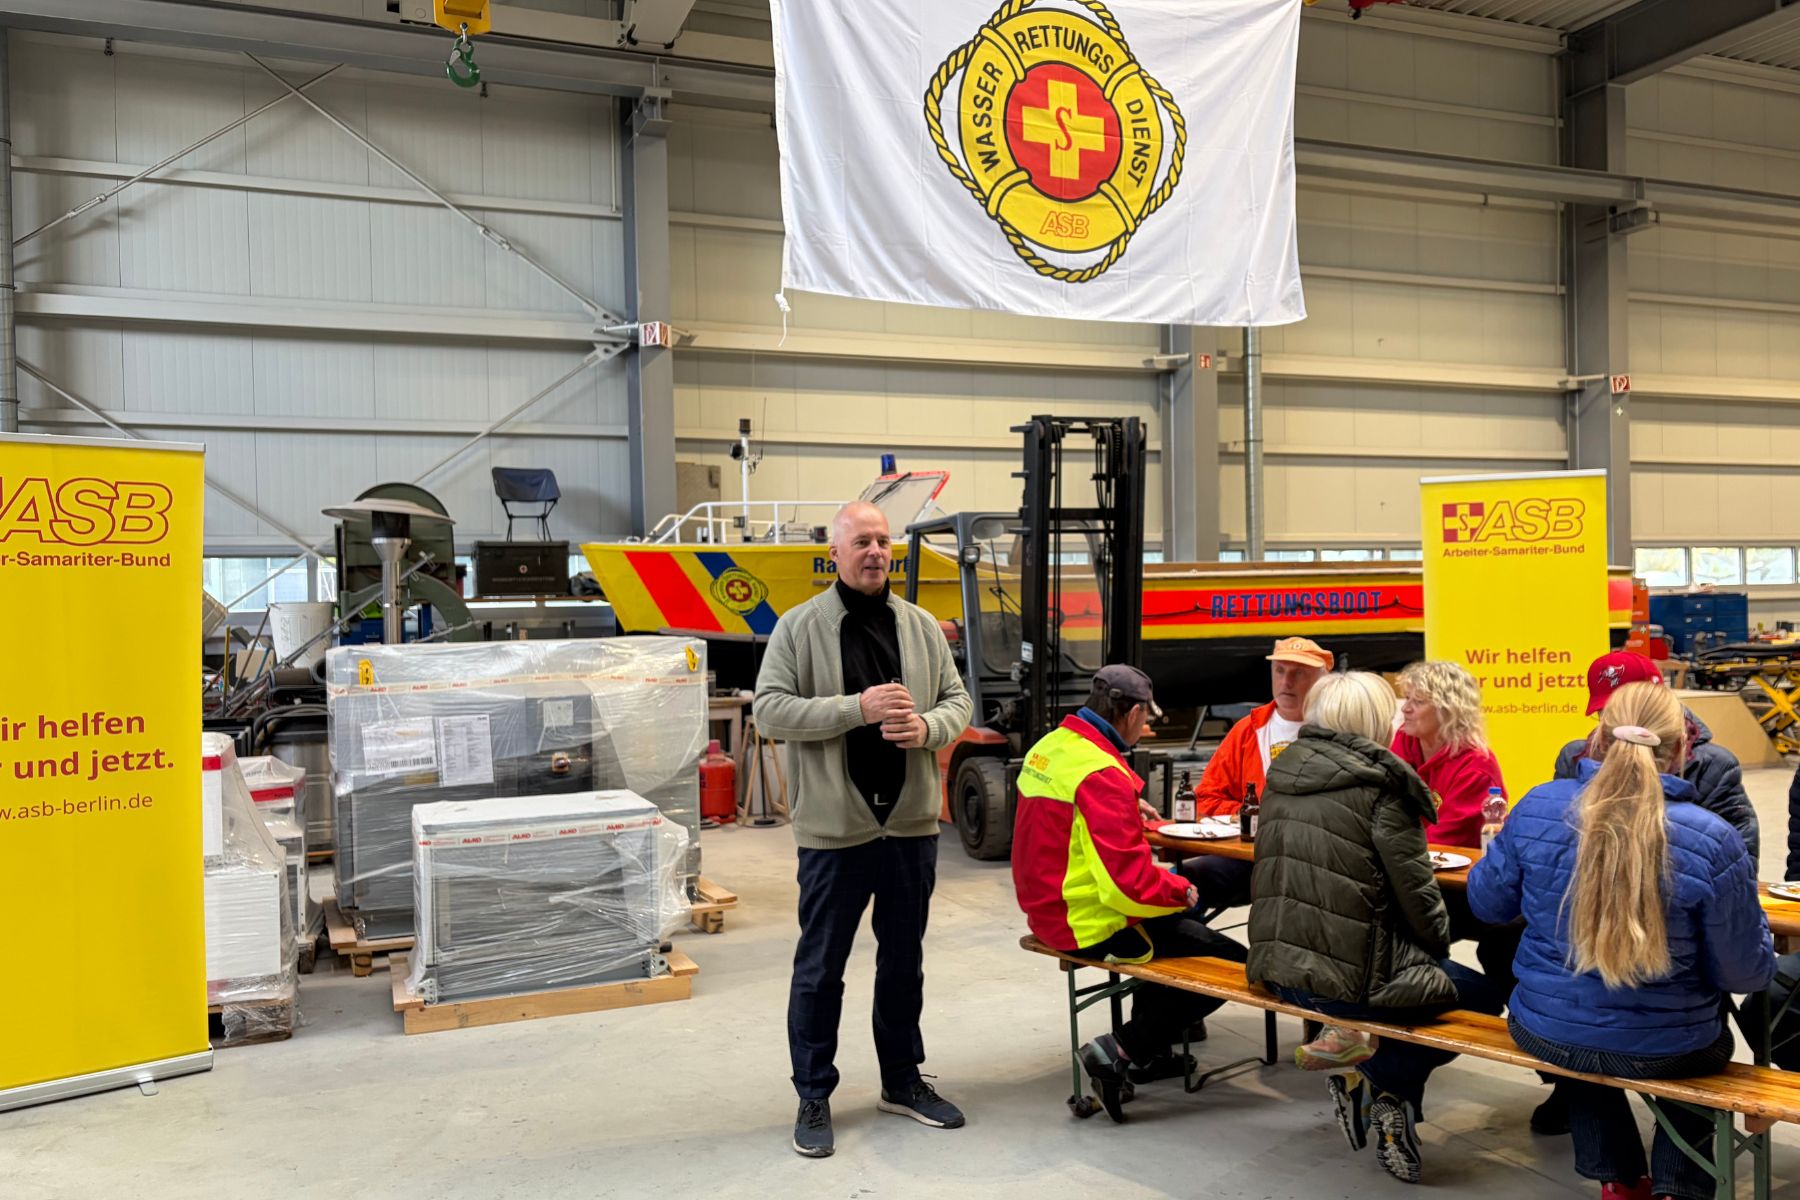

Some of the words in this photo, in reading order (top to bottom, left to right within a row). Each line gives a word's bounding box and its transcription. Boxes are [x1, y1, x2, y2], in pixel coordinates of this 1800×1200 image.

[1013, 25, 1114, 74] RETTUNGS
[973, 61, 1003, 173] WASSER
[1125, 98, 1150, 188] DIENST
[1040, 211, 1089, 239] ASB
[0, 477, 173, 546] ASB
[1474, 498, 1586, 542] ASB
[1, 551, 171, 567] r-Samariter-Bund
[1443, 544, 1585, 557] Arbeiter-Samariter-Bund
[1211, 591, 1382, 618] RETTUNGSBOOT
[1466, 649, 1500, 664] Wir
[1507, 648, 1571, 664] helfen
[1494, 673, 1532, 688] und
[1537, 673, 1586, 692] jetzt
[1, 717, 26, 741] ir
[38, 712, 145, 740] helfen
[14, 751, 79, 779] und
[88, 748, 174, 780] jetzt.
[0, 793, 153, 820] w.asb-berlin.de
